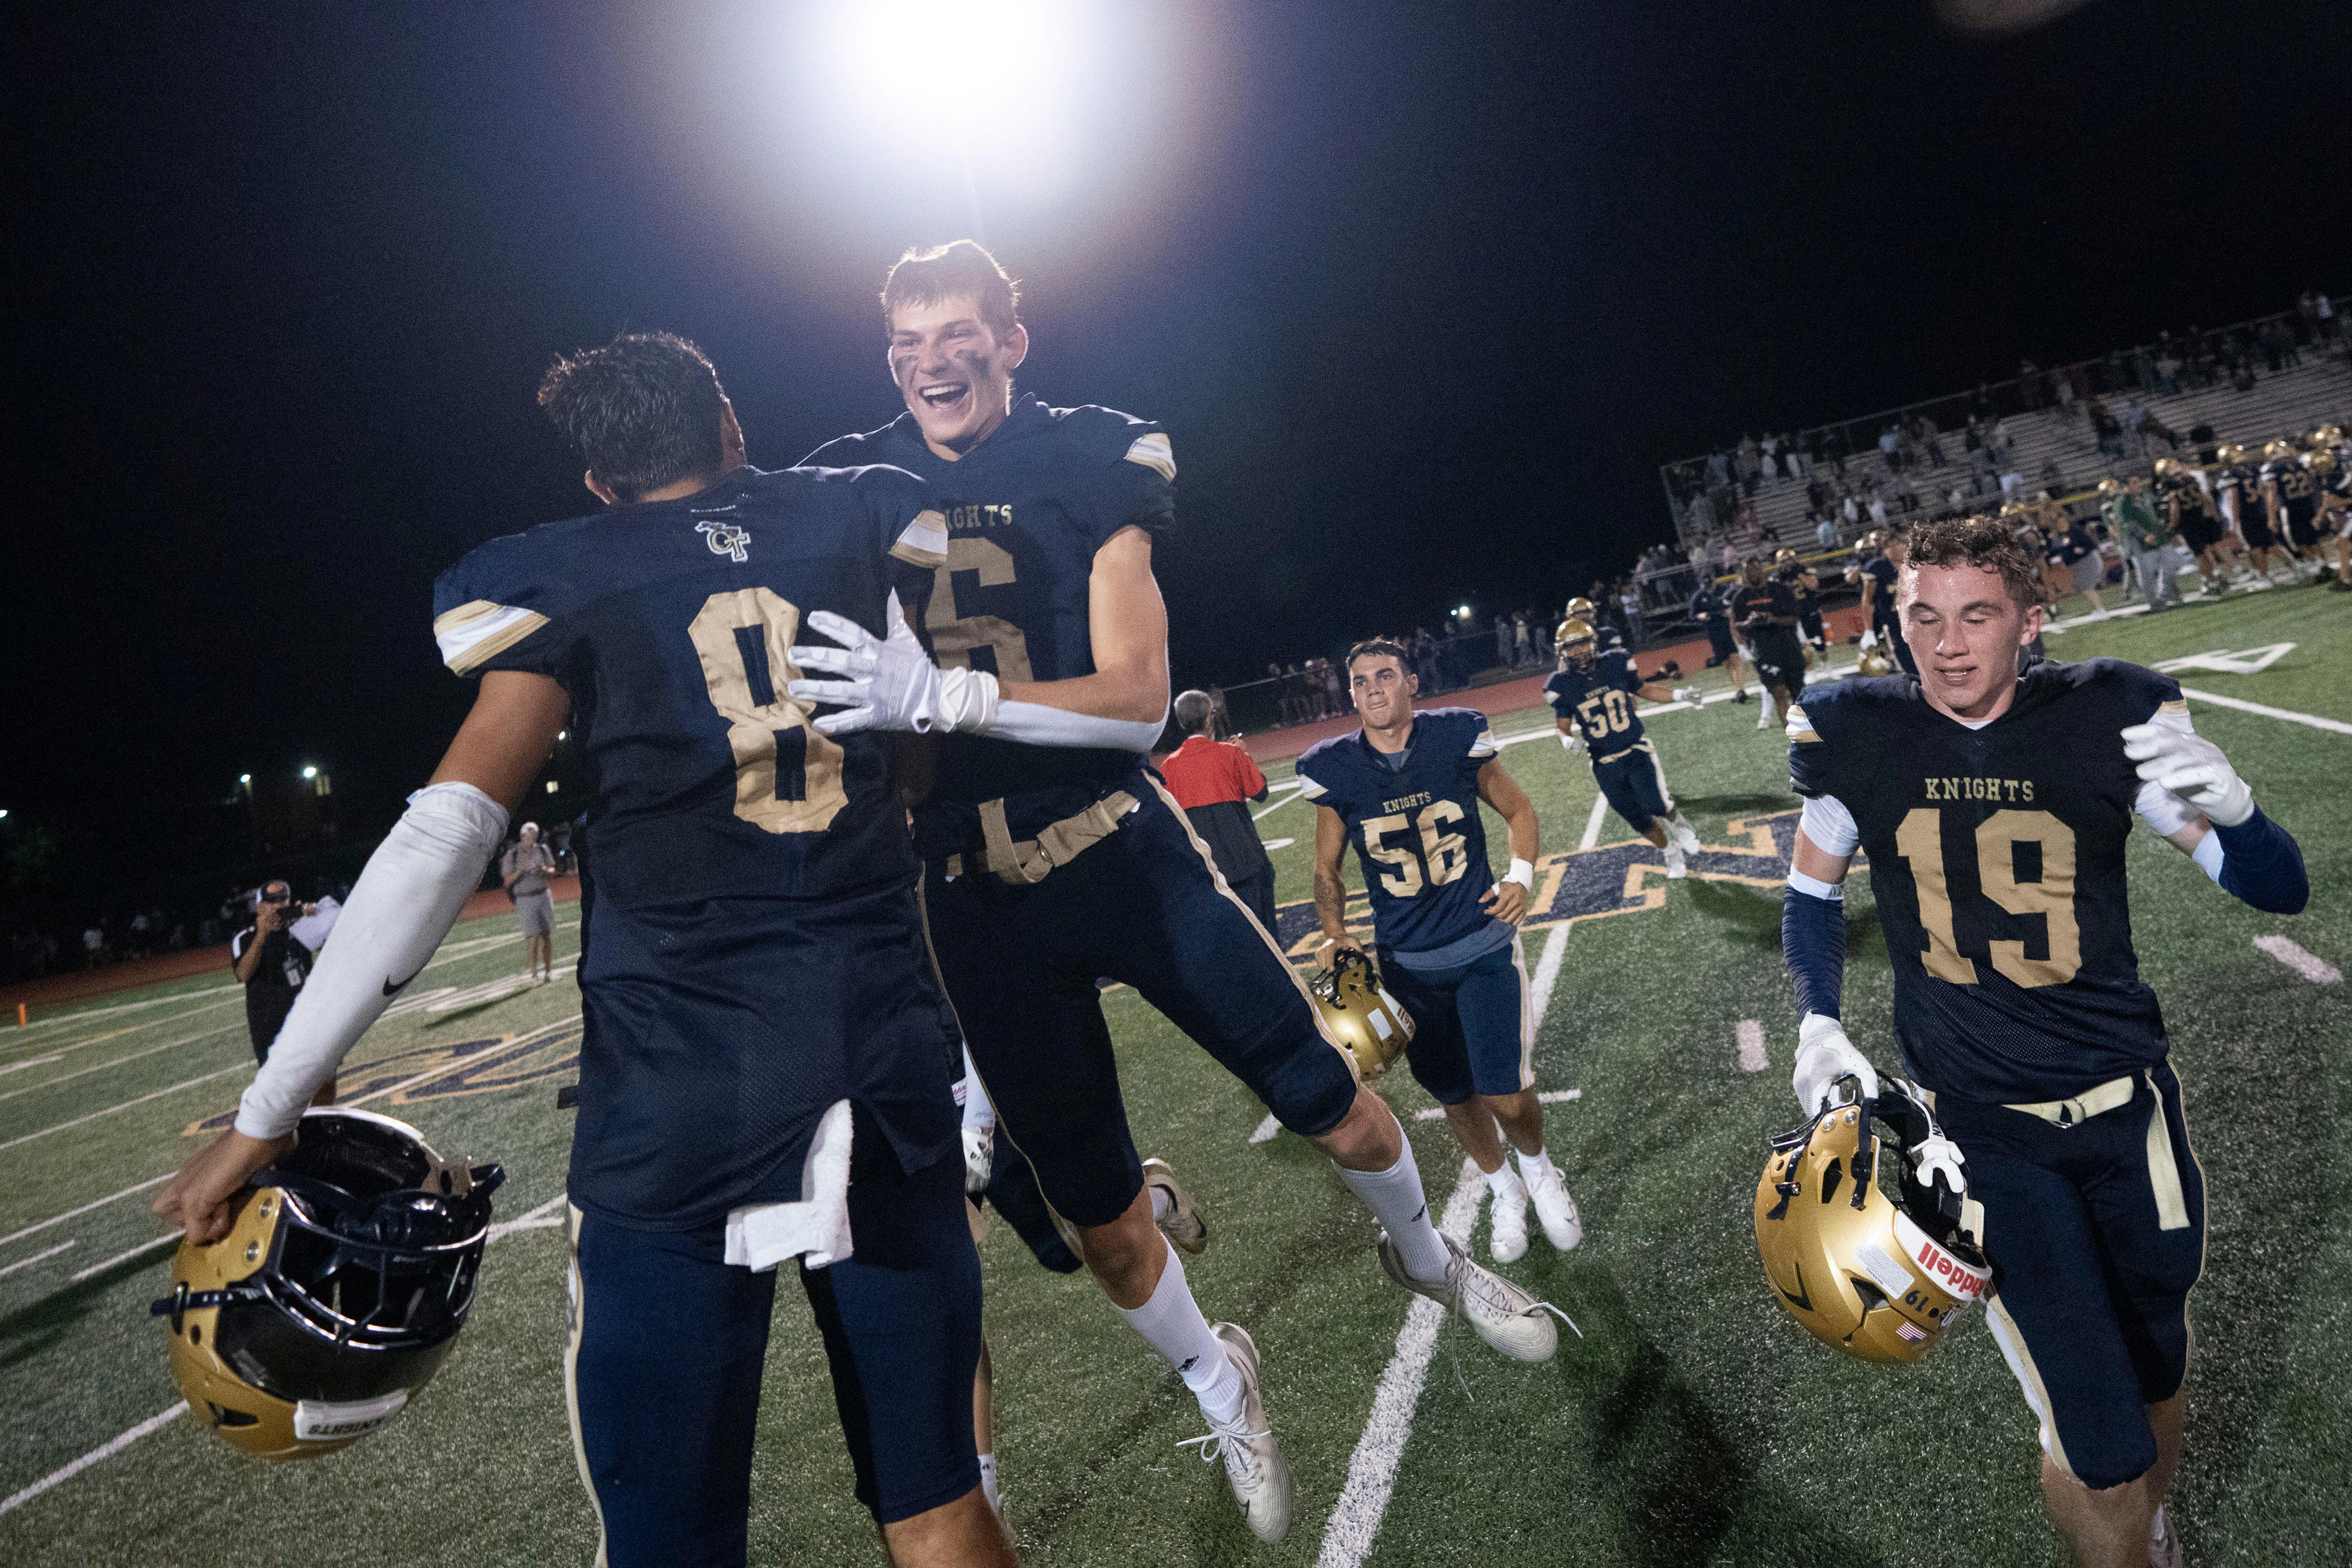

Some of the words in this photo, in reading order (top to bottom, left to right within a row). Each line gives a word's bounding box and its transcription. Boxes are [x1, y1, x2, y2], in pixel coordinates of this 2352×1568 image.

[945, 504, 1013, 530] IGHTS
[925, 537, 1033, 683] 6
[688, 587, 849, 834] 8
[1577, 689, 1630, 738] 50
[1382, 792, 1432, 813] KNIGHTS
[1925, 778, 2034, 801] KNIGHTS
[1360, 800, 1468, 897] 56
[1896, 809, 2082, 989] 19
[1905, 1290, 1929, 1312] 19
